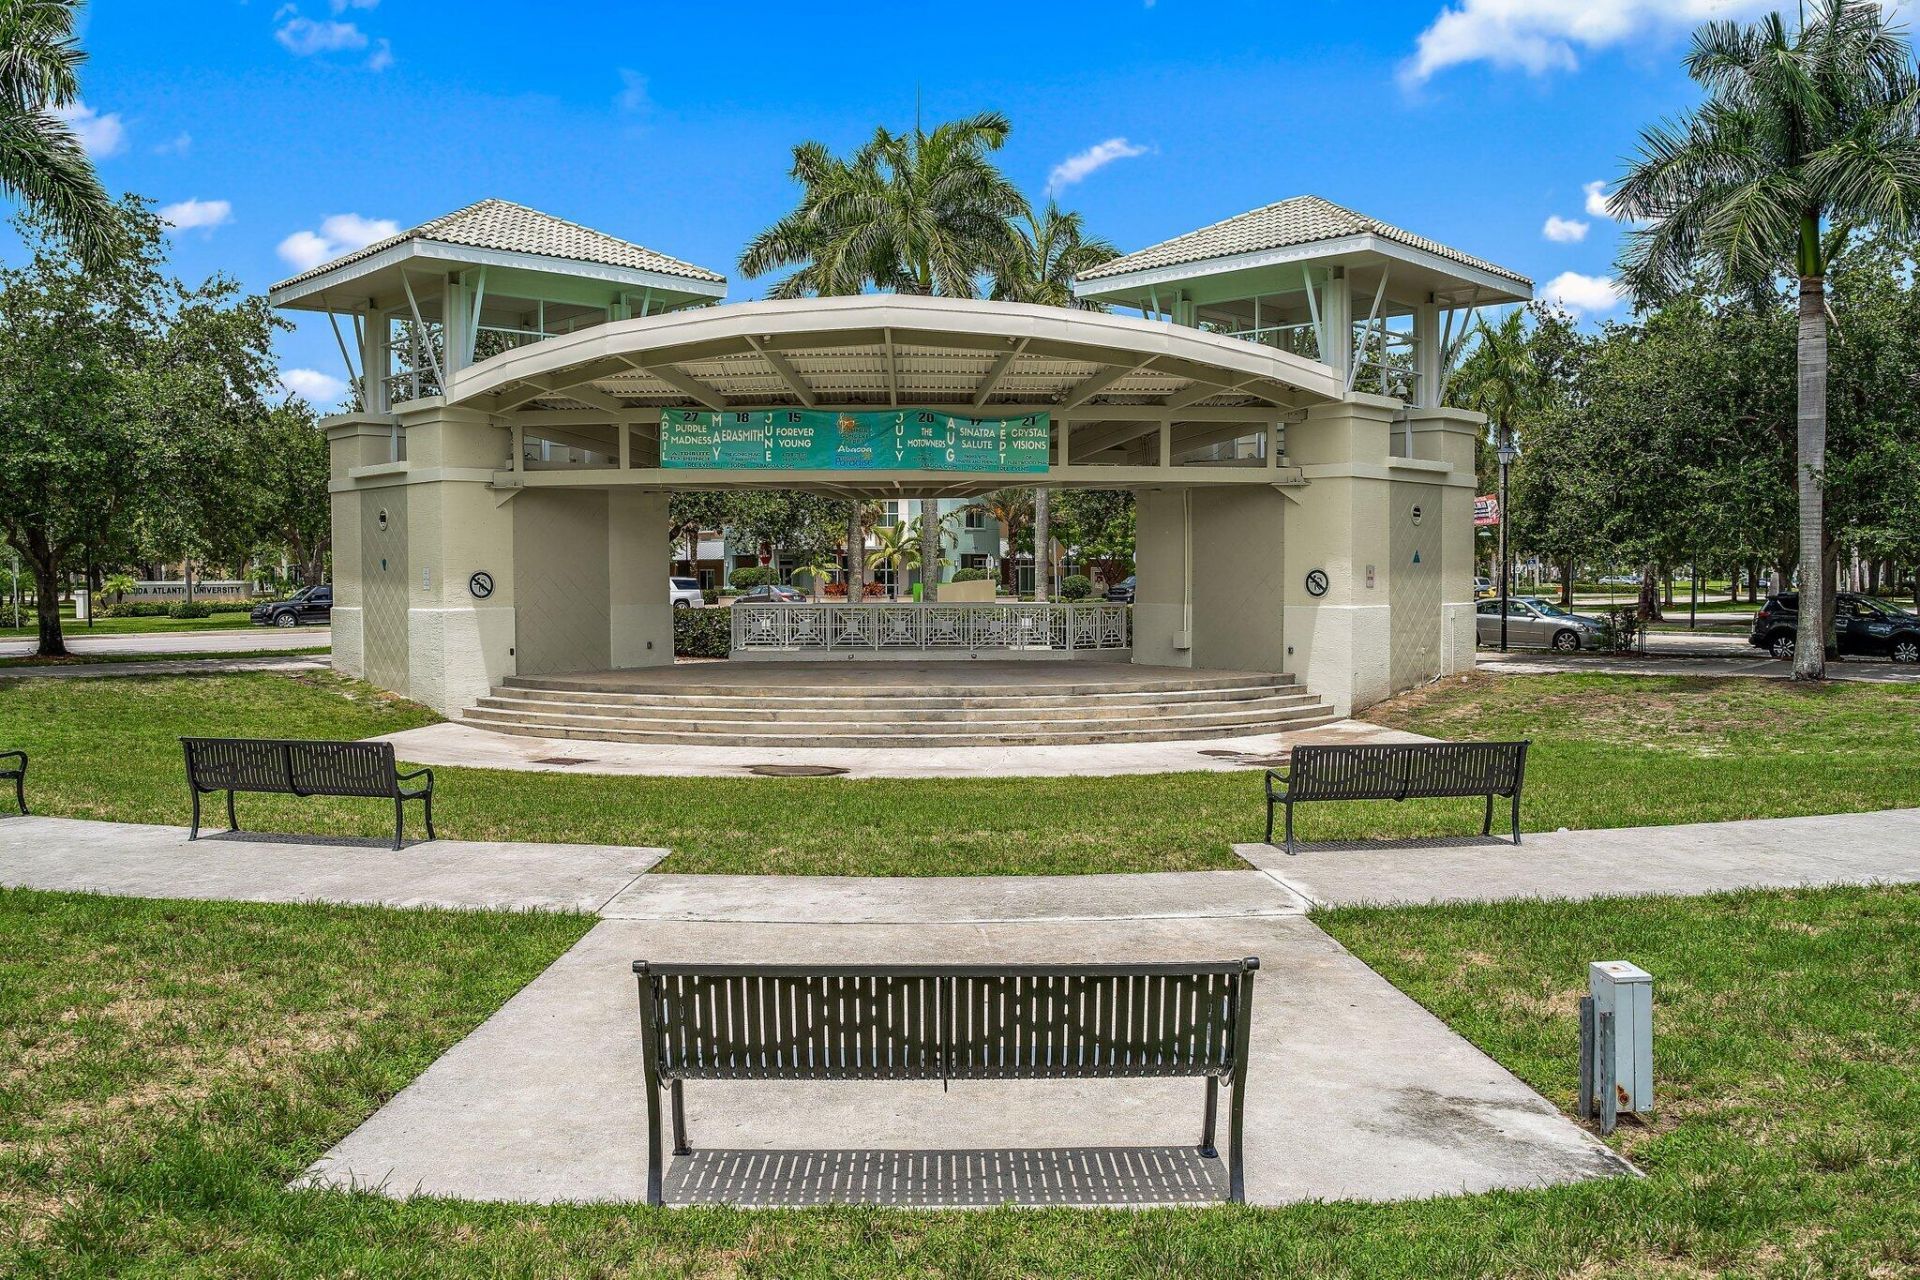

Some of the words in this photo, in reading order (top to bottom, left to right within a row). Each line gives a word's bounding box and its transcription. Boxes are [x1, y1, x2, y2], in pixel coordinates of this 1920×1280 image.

[683, 412, 699, 422] 27
[736, 413, 750, 423] 18
[788, 412, 802, 423] 15
[918, 412, 935, 423] 20
[1022, 417, 1037, 427] 21
[675, 424, 707, 433] PURPLE
[776, 428, 814, 437] FOREVER
[921, 428, 933, 437] THE
[960, 428, 996, 438] SINATRA
[1011, 428, 1048, 438] CRYSTAL
[661, 412, 670, 461] APRIL
[670, 435, 712, 445] MADNESS
[711, 414, 722, 460] MAY
[722, 429, 764, 442] ERASMITH
[764, 413, 773, 462] JUNE
[895, 412, 904, 461] JULY
[946, 417, 956, 462] AUG
[779, 439, 812, 448] YOUNG
[907, 439, 946, 448] MOTOWNERS
[962, 440, 993, 449] SALUTE
[999, 420, 1007, 464] SEPT
[1012, 440, 1047, 450] VISIONS
[837, 445, 872, 453] Abacoa
[193, 586, 241, 594] UNIVERSITY
